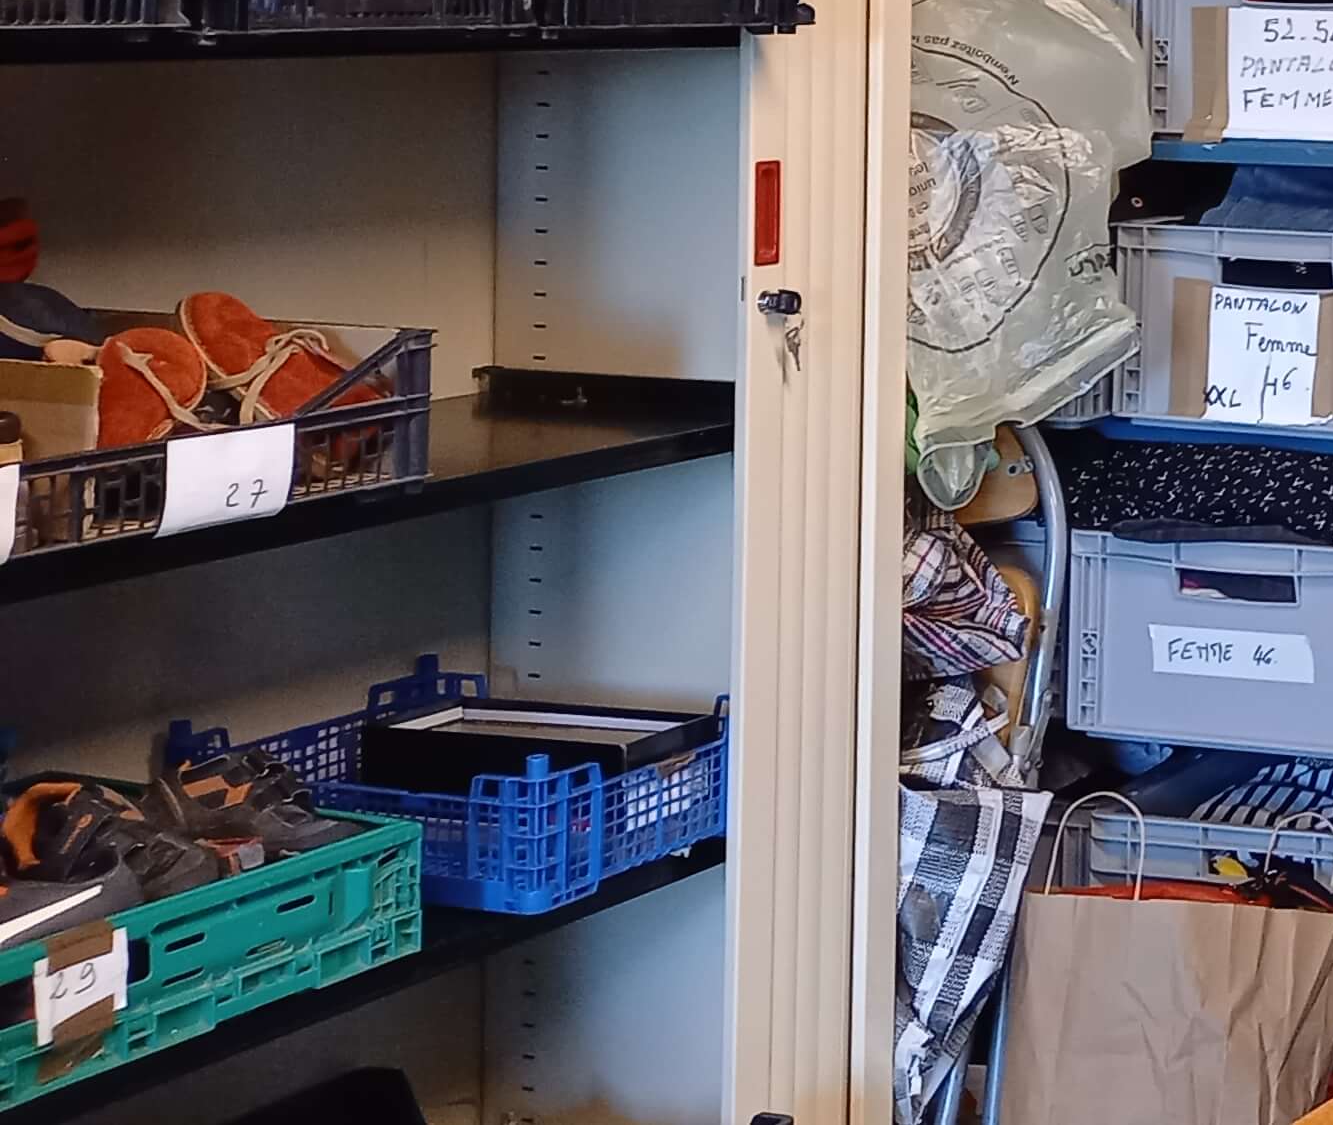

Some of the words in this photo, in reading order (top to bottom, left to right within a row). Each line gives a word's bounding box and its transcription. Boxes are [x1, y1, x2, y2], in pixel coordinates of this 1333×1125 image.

[1243, 87, 1333, 112] FEMME
[1215, 293, 1308, 314] PANTALON
[1244, 322, 1319, 357] Femme
[225, 478, 270, 509] 27
[1168, 638, 1234, 663] FEMME
[49, 962, 97, 1000] 29
